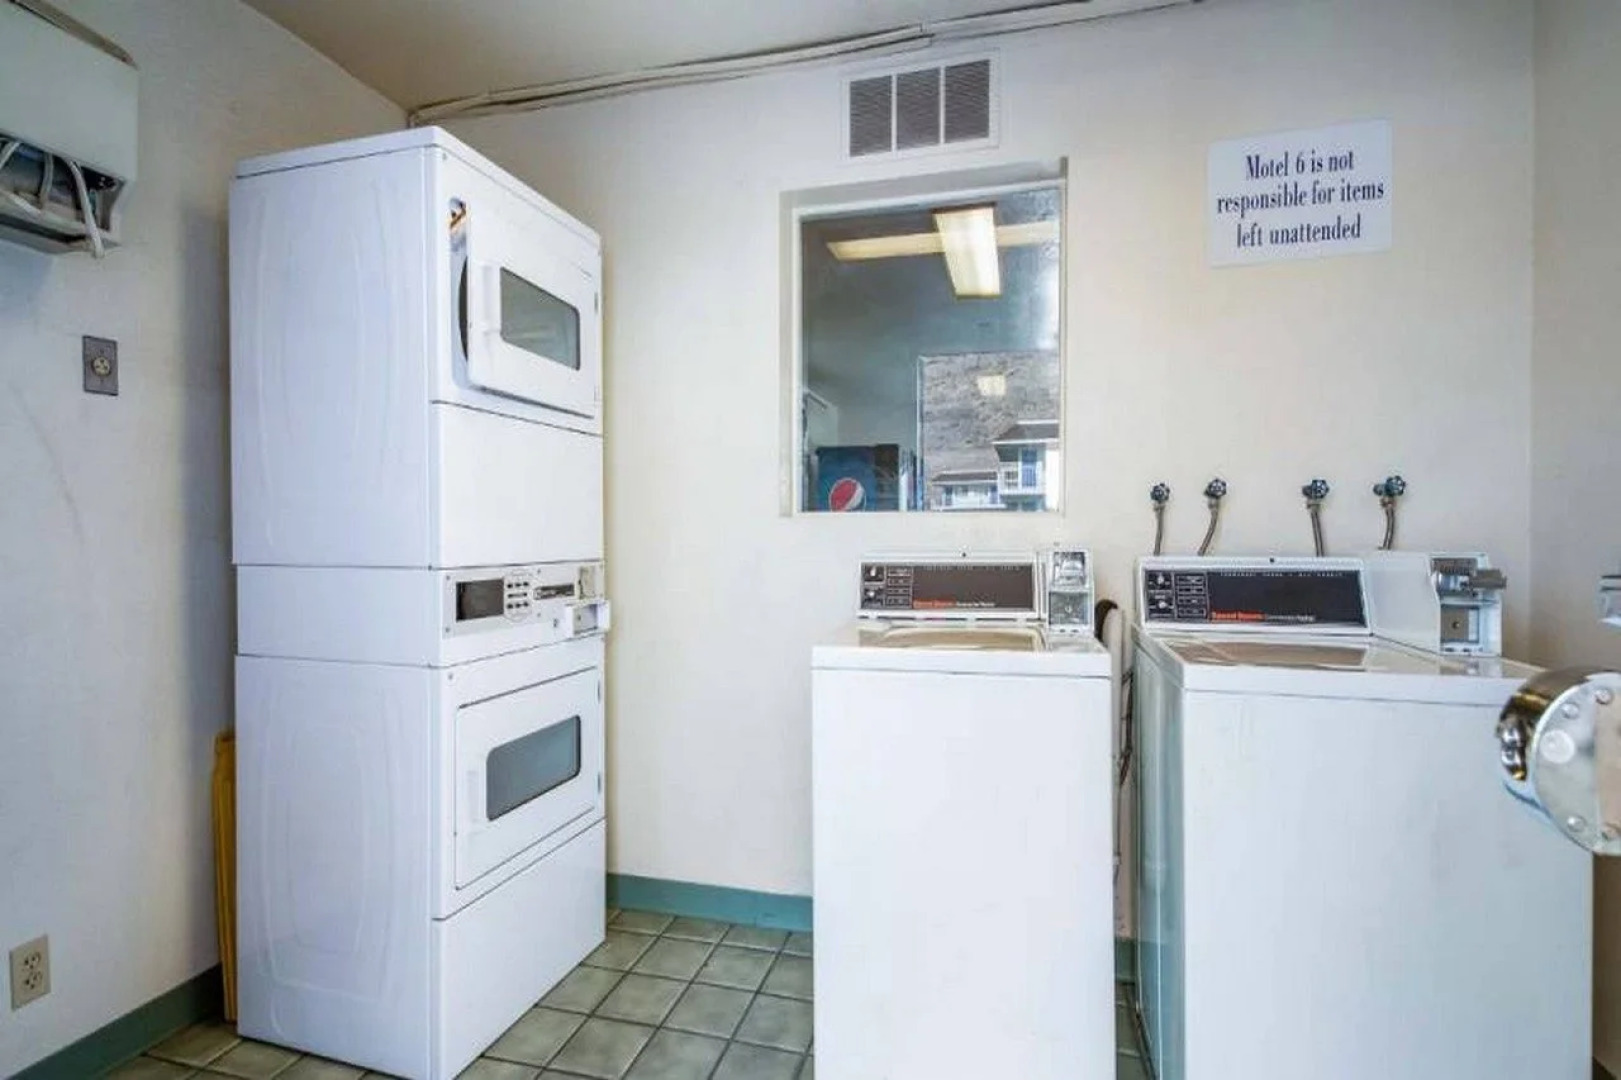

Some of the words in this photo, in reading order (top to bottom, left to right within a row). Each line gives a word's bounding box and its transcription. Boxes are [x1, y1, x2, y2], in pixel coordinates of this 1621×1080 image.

[1246, 151, 1288, 179] Motel
[1296, 151, 1305, 174] 6
[1311, 149, 1323, 173] is
[1328, 151, 1354, 172] not
[1216, 181, 1307, 218] responsible
[1312, 180, 1335, 205] for
[1340, 178, 1384, 202] items
[1236, 222, 1262, 248] left
[1269, 212, 1361, 245] unattended
